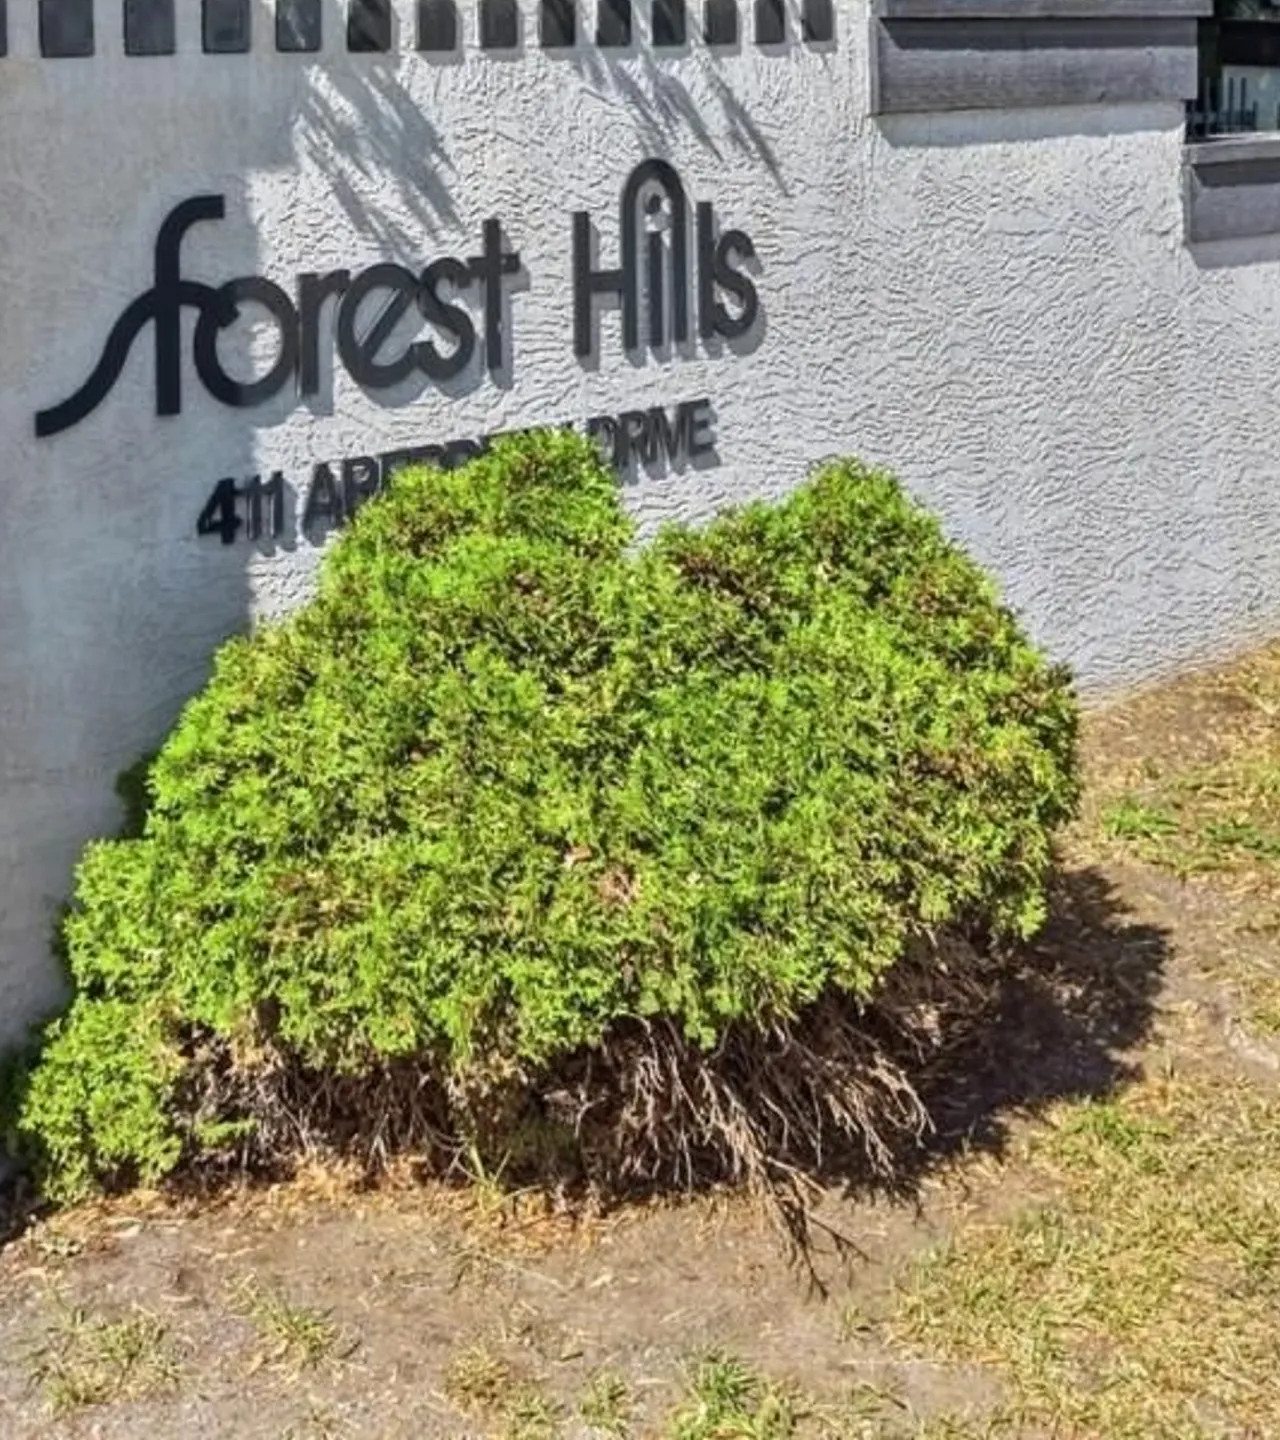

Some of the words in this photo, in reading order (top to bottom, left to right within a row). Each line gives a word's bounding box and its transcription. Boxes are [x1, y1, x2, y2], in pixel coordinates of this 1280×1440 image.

[571, 158, 758, 357] Hills
[196, 470, 287, 545] 411
[586, 398, 712, 468] DRIVE
